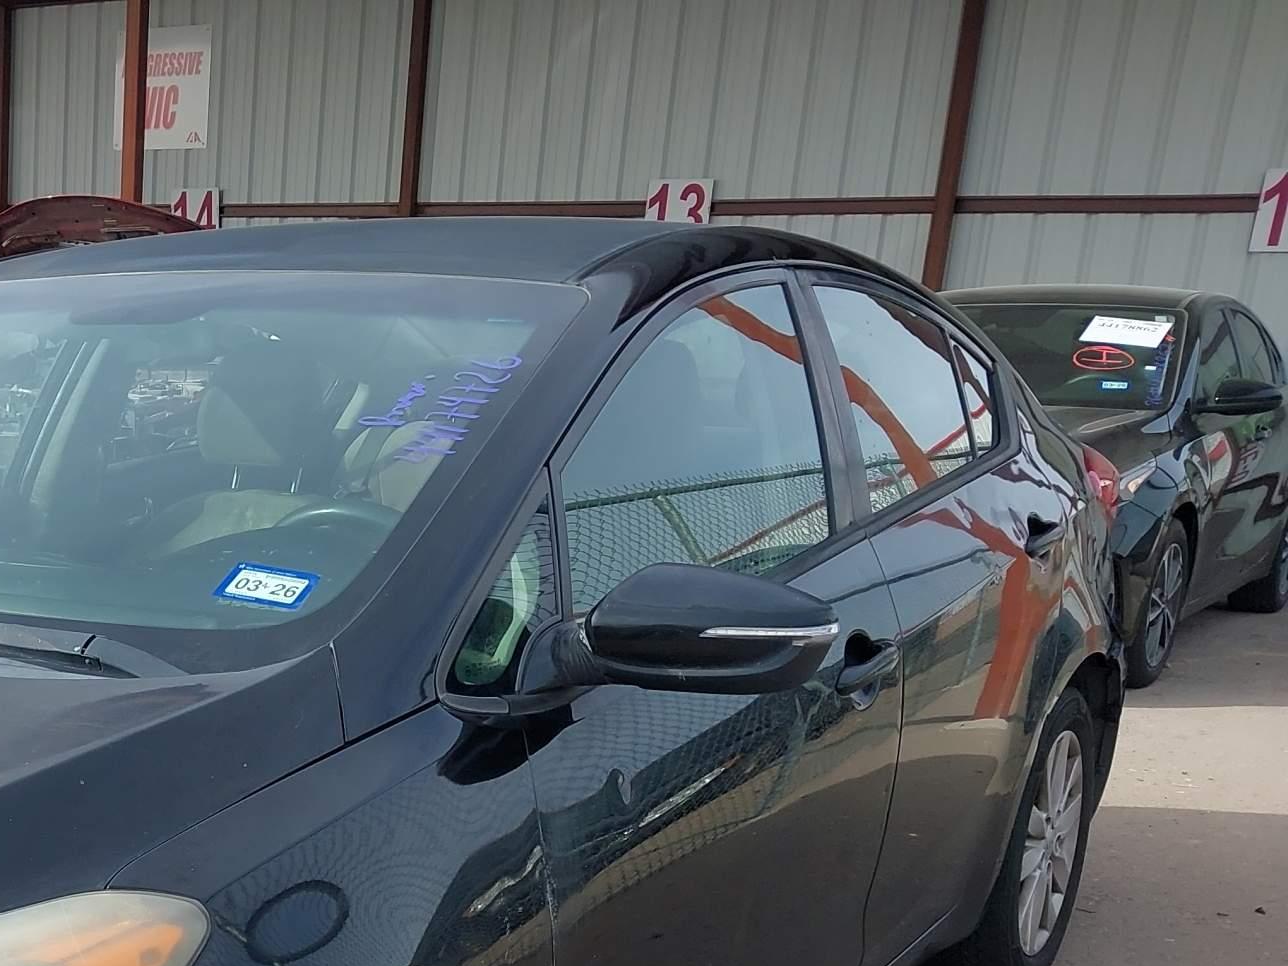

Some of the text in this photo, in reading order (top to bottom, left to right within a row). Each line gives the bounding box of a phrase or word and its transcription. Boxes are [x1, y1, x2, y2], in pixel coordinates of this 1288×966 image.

[122, 51, 204, 78] GRESSIVE
[144, 84, 180, 130] VIC
[173, 190, 217, 230] 14
[647, 183, 707, 224] 13
[234, 577, 263, 592] 03
[269, 583, 300, 599] 26
